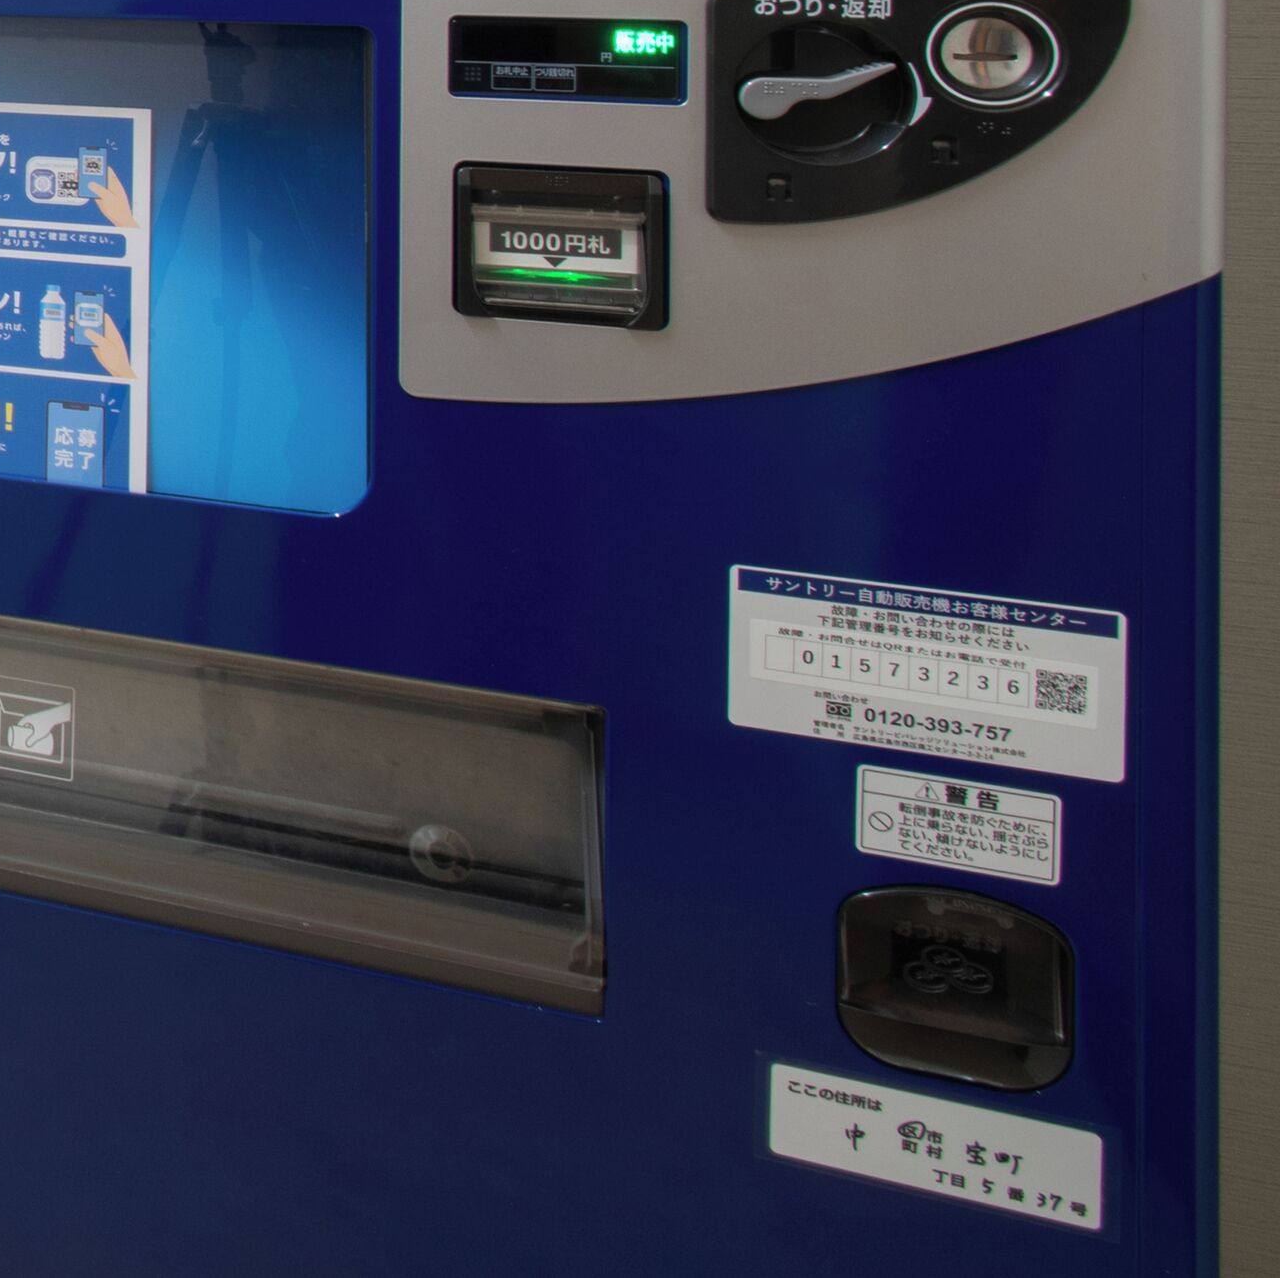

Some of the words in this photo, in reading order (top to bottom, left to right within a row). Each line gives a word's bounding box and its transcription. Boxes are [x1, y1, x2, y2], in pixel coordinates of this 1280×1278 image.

[614, 29, 675, 55] 販売中
[500, 230, 611, 255] 1000円札
[54, 425, 97, 449] 応募
[54, 450, 96, 470] 完了
[765, 577, 1088, 628] サントリー自動販売機お客様センター
[813, 690, 869, 705] お問い合わせ
[864, 707, 1013, 743] 0120-393-757
[945, 785, 1000, 811] 警告
[787, 1080, 883, 1112] ここの住所は
[844, 1123, 866, 1151] 中
